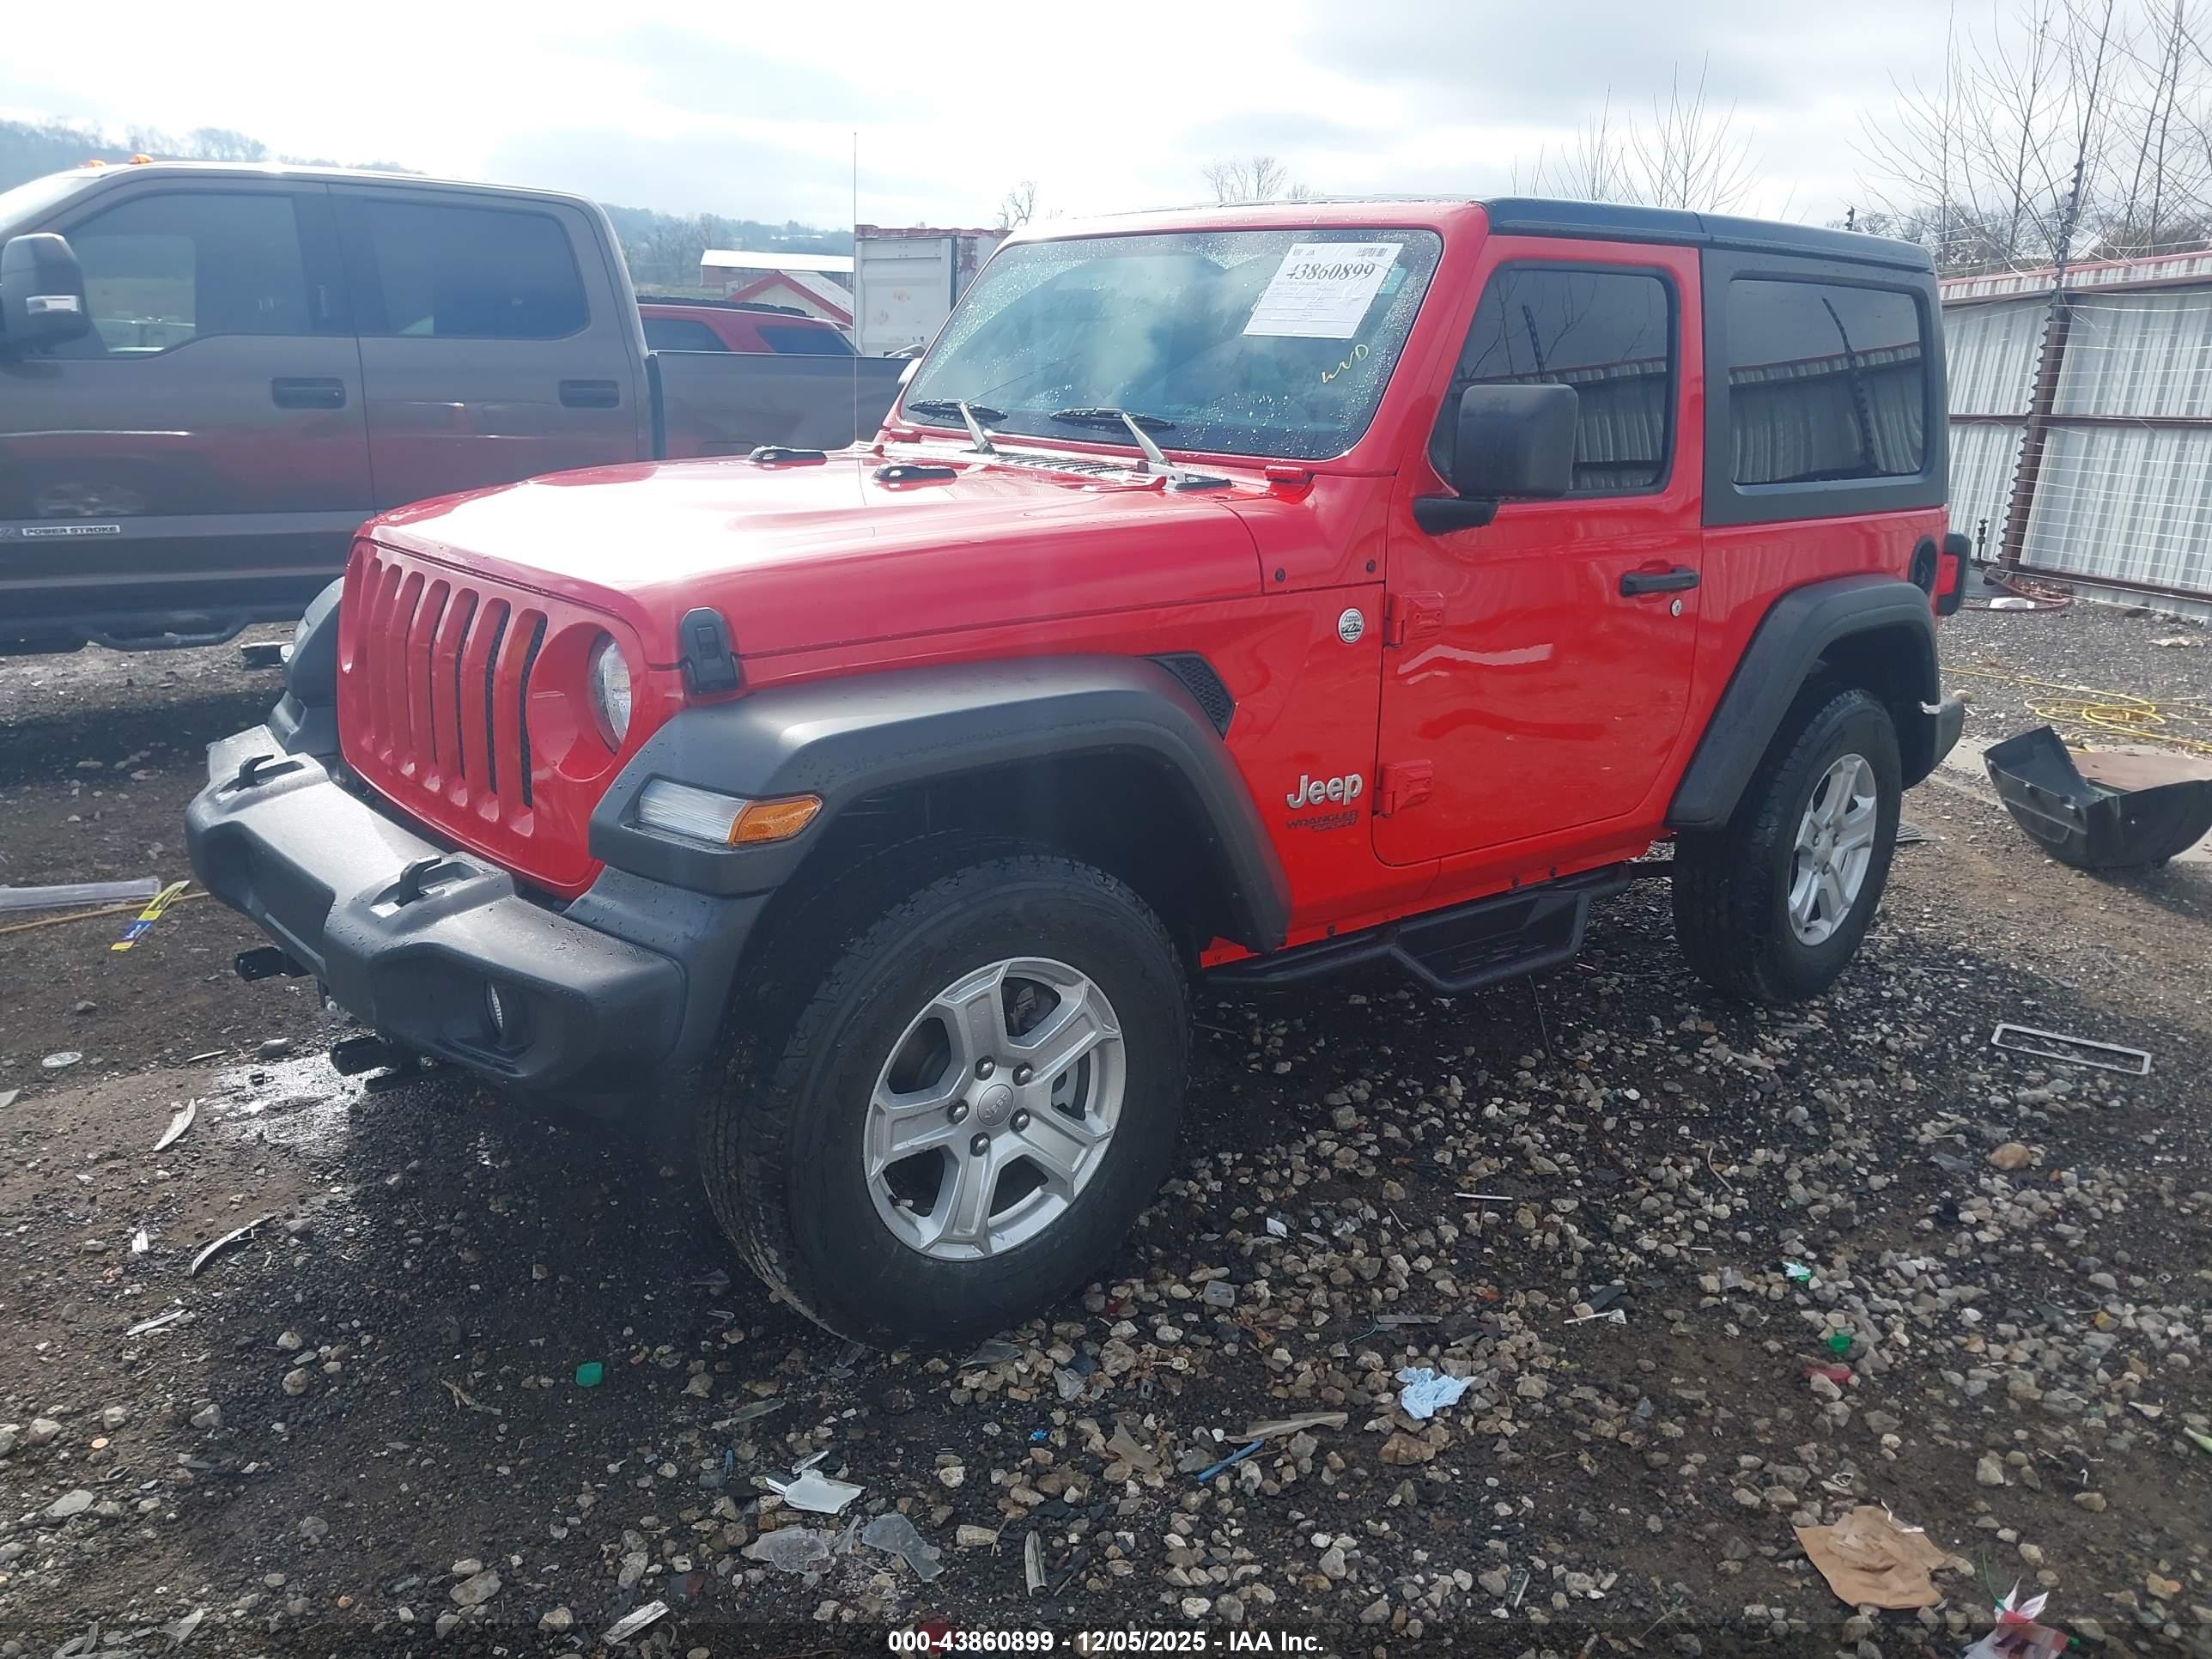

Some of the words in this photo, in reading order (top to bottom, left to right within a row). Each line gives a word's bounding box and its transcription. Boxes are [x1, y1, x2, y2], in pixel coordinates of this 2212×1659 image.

[1285, 263, 1376, 281] 43860899
[26, 527, 68, 536] POWER
[70, 526, 118, 535] STROKE
[1285, 773, 1364, 809] Jeep
[1286, 810, 1359, 830] WRANGLER
